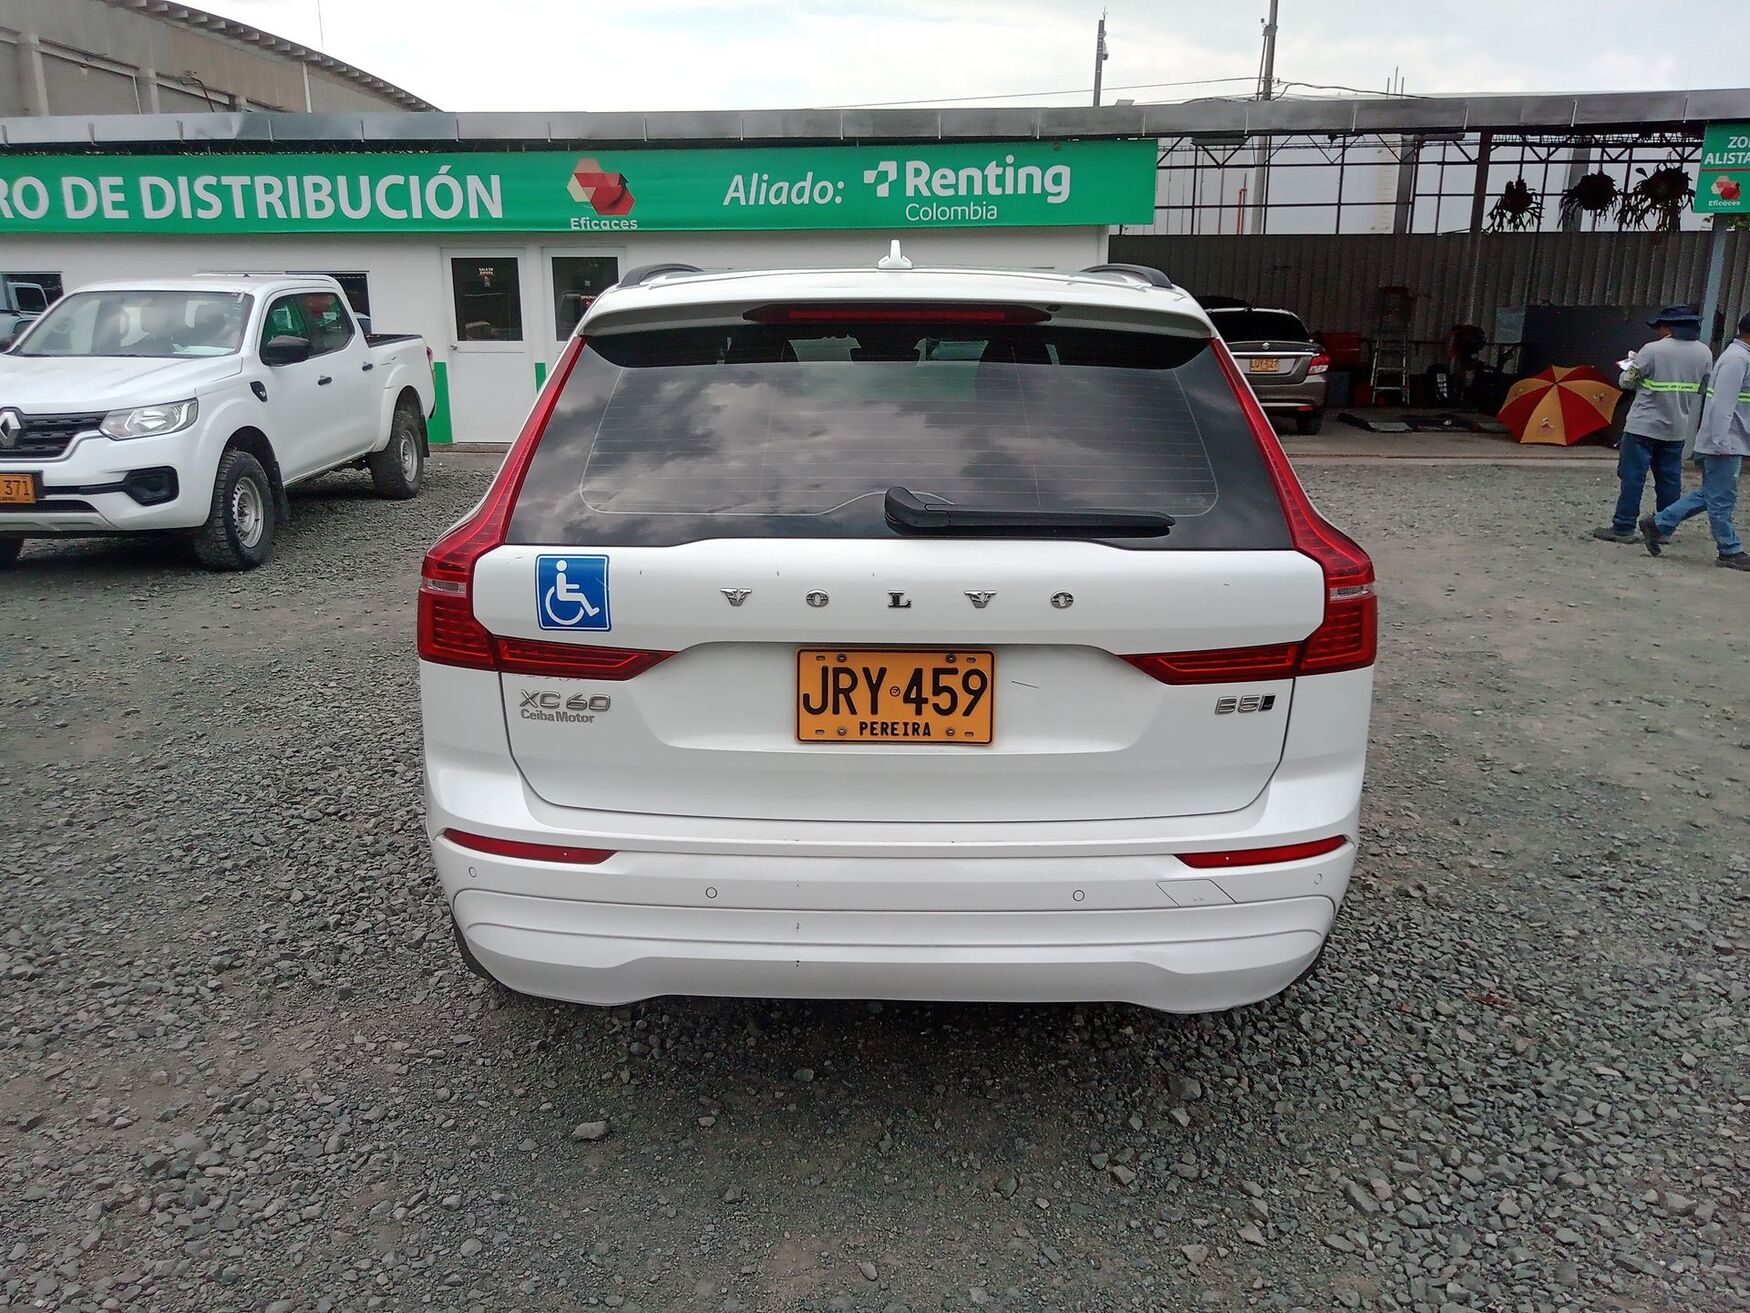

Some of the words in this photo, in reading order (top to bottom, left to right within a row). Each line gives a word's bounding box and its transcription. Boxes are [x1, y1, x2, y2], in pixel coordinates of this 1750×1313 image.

[1727, 136, 1750, 148] ZO
[1705, 152, 1750, 165] ALISTA
[905, 154, 1071, 204] Renting
[61, 176, 130, 219] DE
[139, 165, 503, 220] DISTRIBUCIÓN
[723, 172, 845, 206] Aliado:
[905, 201, 998, 222] Colombia
[570, 217, 638, 230] Eficaces
[3, 480, 30, 496] 371
[720, 588, 1075, 609] VOLVO
[802, 665, 888, 716] JRY
[902, 667, 988, 717] 459
[520, 708, 555, 722] Ceiba
[555, 711, 595, 723] Motor
[859, 721, 931, 737] PEREIRA
